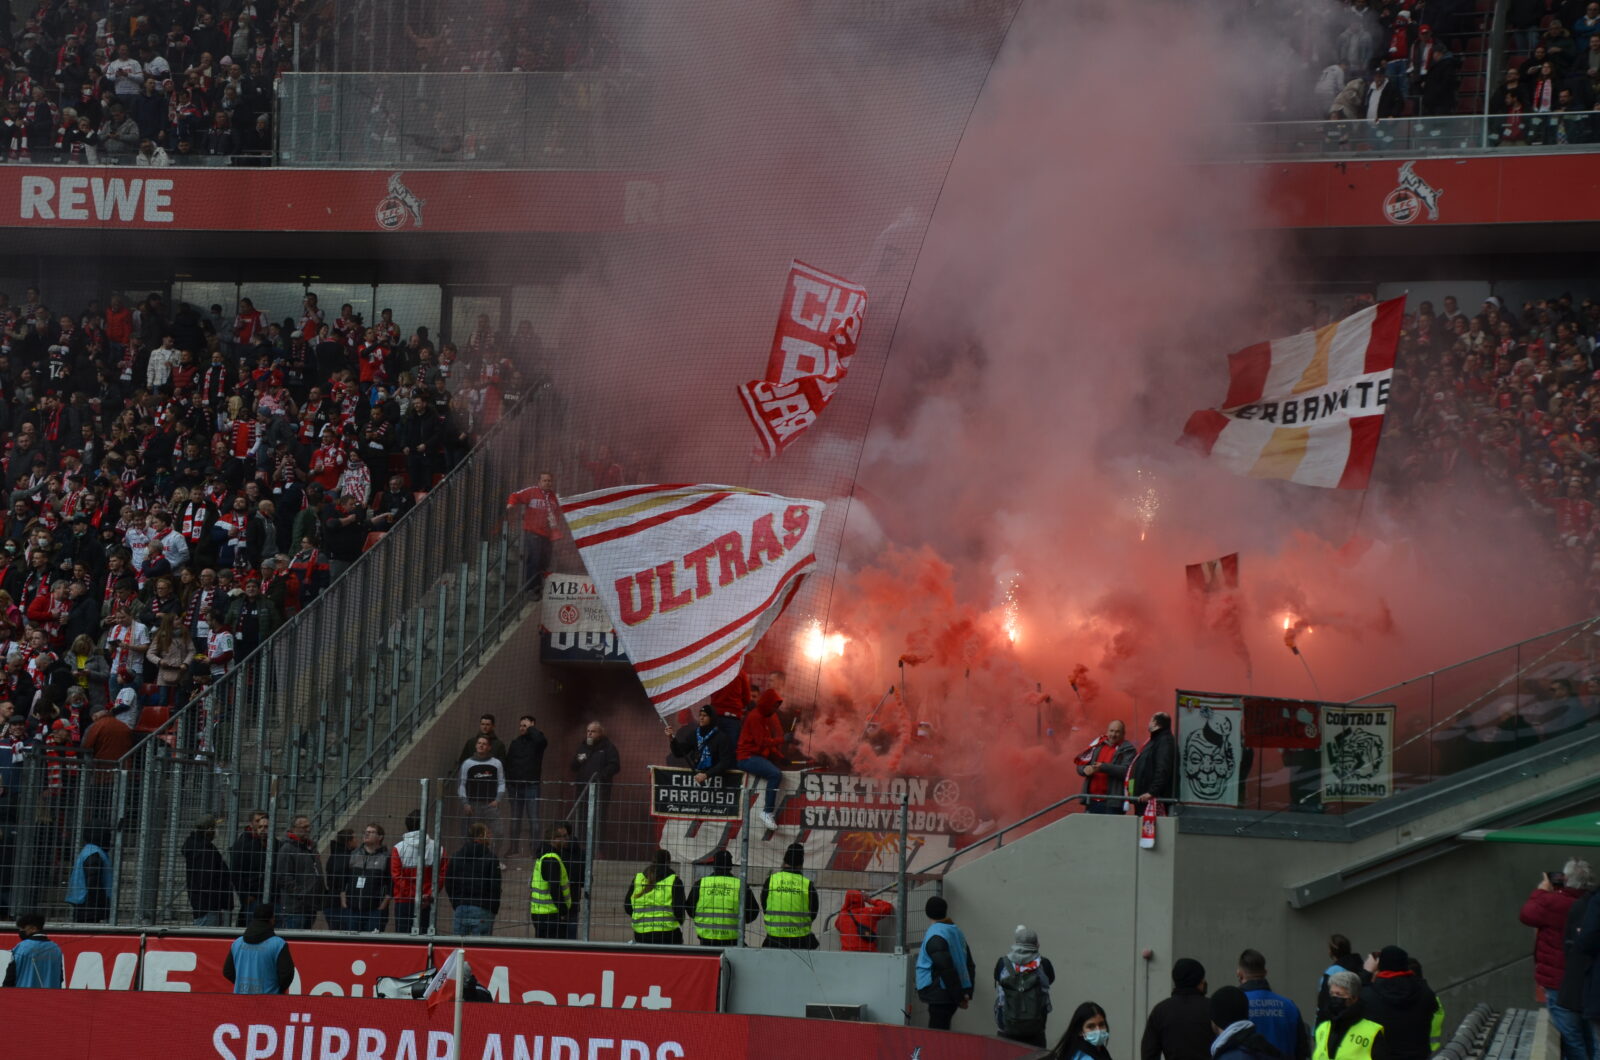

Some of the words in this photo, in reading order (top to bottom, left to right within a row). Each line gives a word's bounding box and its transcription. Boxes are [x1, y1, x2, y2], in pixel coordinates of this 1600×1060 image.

[20, 175, 174, 222] REWE
[614, 504, 811, 627] ULTRAS
[1326, 712, 1373, 726] CONTRO
[1376, 713, 1387, 725] IL
[659, 789, 735, 804] PARADISO
[804, 774, 929, 806] SEKTION
[1325, 784, 1386, 797] RAZZISMO
[805, 806, 950, 833] STADIONVERBOT
[1249, 999, 1284, 1007] ECURITY
[1249, 1009, 1284, 1017] SERVICE
[1349, 1033, 1370, 1048] 100
